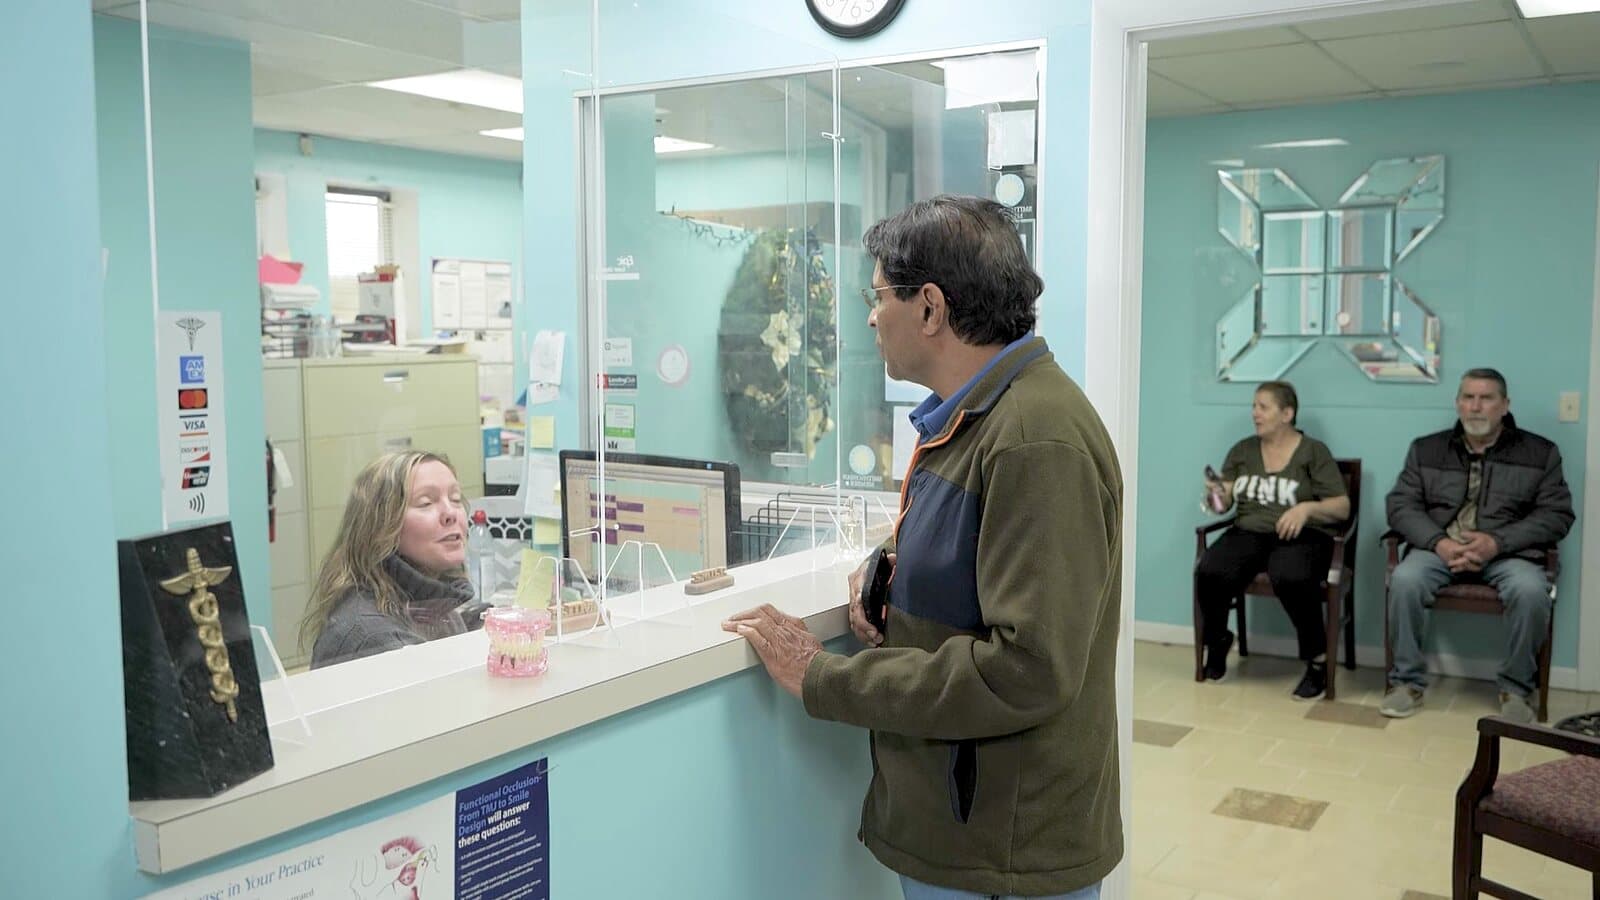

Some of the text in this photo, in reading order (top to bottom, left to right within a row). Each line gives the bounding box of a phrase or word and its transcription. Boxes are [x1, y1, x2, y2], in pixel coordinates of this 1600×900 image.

[184, 420, 206, 431] VISA
[1232, 475, 1299, 506] PINK
[459, 776, 542, 813] Functional Occlusion-
[459, 790, 530, 825] From TMJ to Smile
[458, 801, 531, 837] Design will answer
[458, 832, 481, 849] these
[481, 816, 521, 841] questions:
[228, 881, 241, 897] in
[244, 871, 274, 890] Your
[279, 855, 325, 879] Practice
